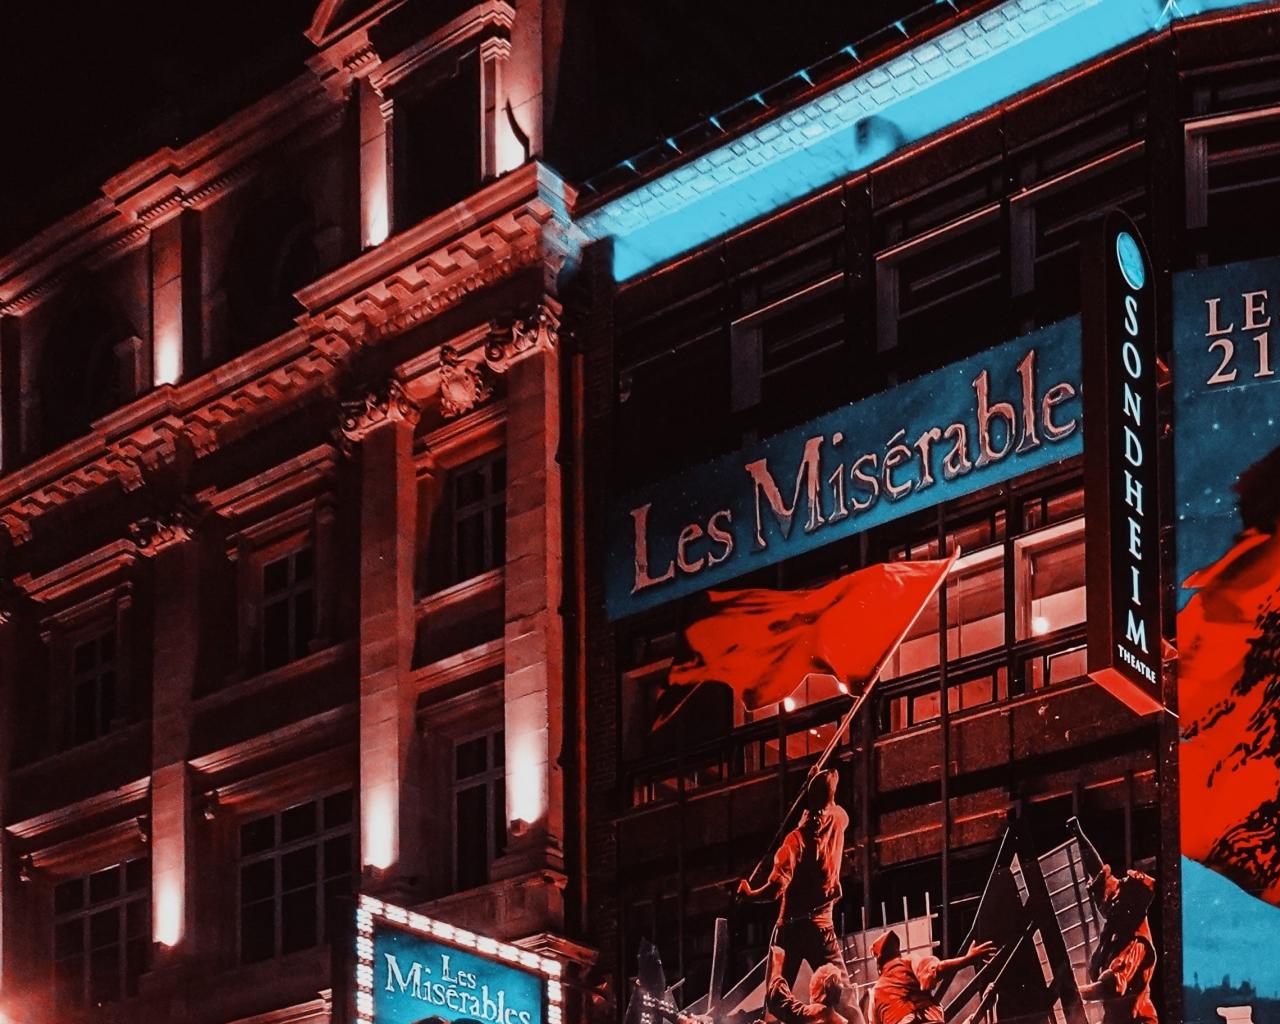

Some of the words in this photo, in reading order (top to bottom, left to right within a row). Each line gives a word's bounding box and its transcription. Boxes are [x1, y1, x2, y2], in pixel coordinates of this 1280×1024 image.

[630, 502, 734, 596] Les
[745, 349, 1084, 552] Misérable
[1121, 294, 1149, 655] SONDHEIM
[1118, 644, 1157, 685] THEATRE
[441, 954, 477, 989] Les
